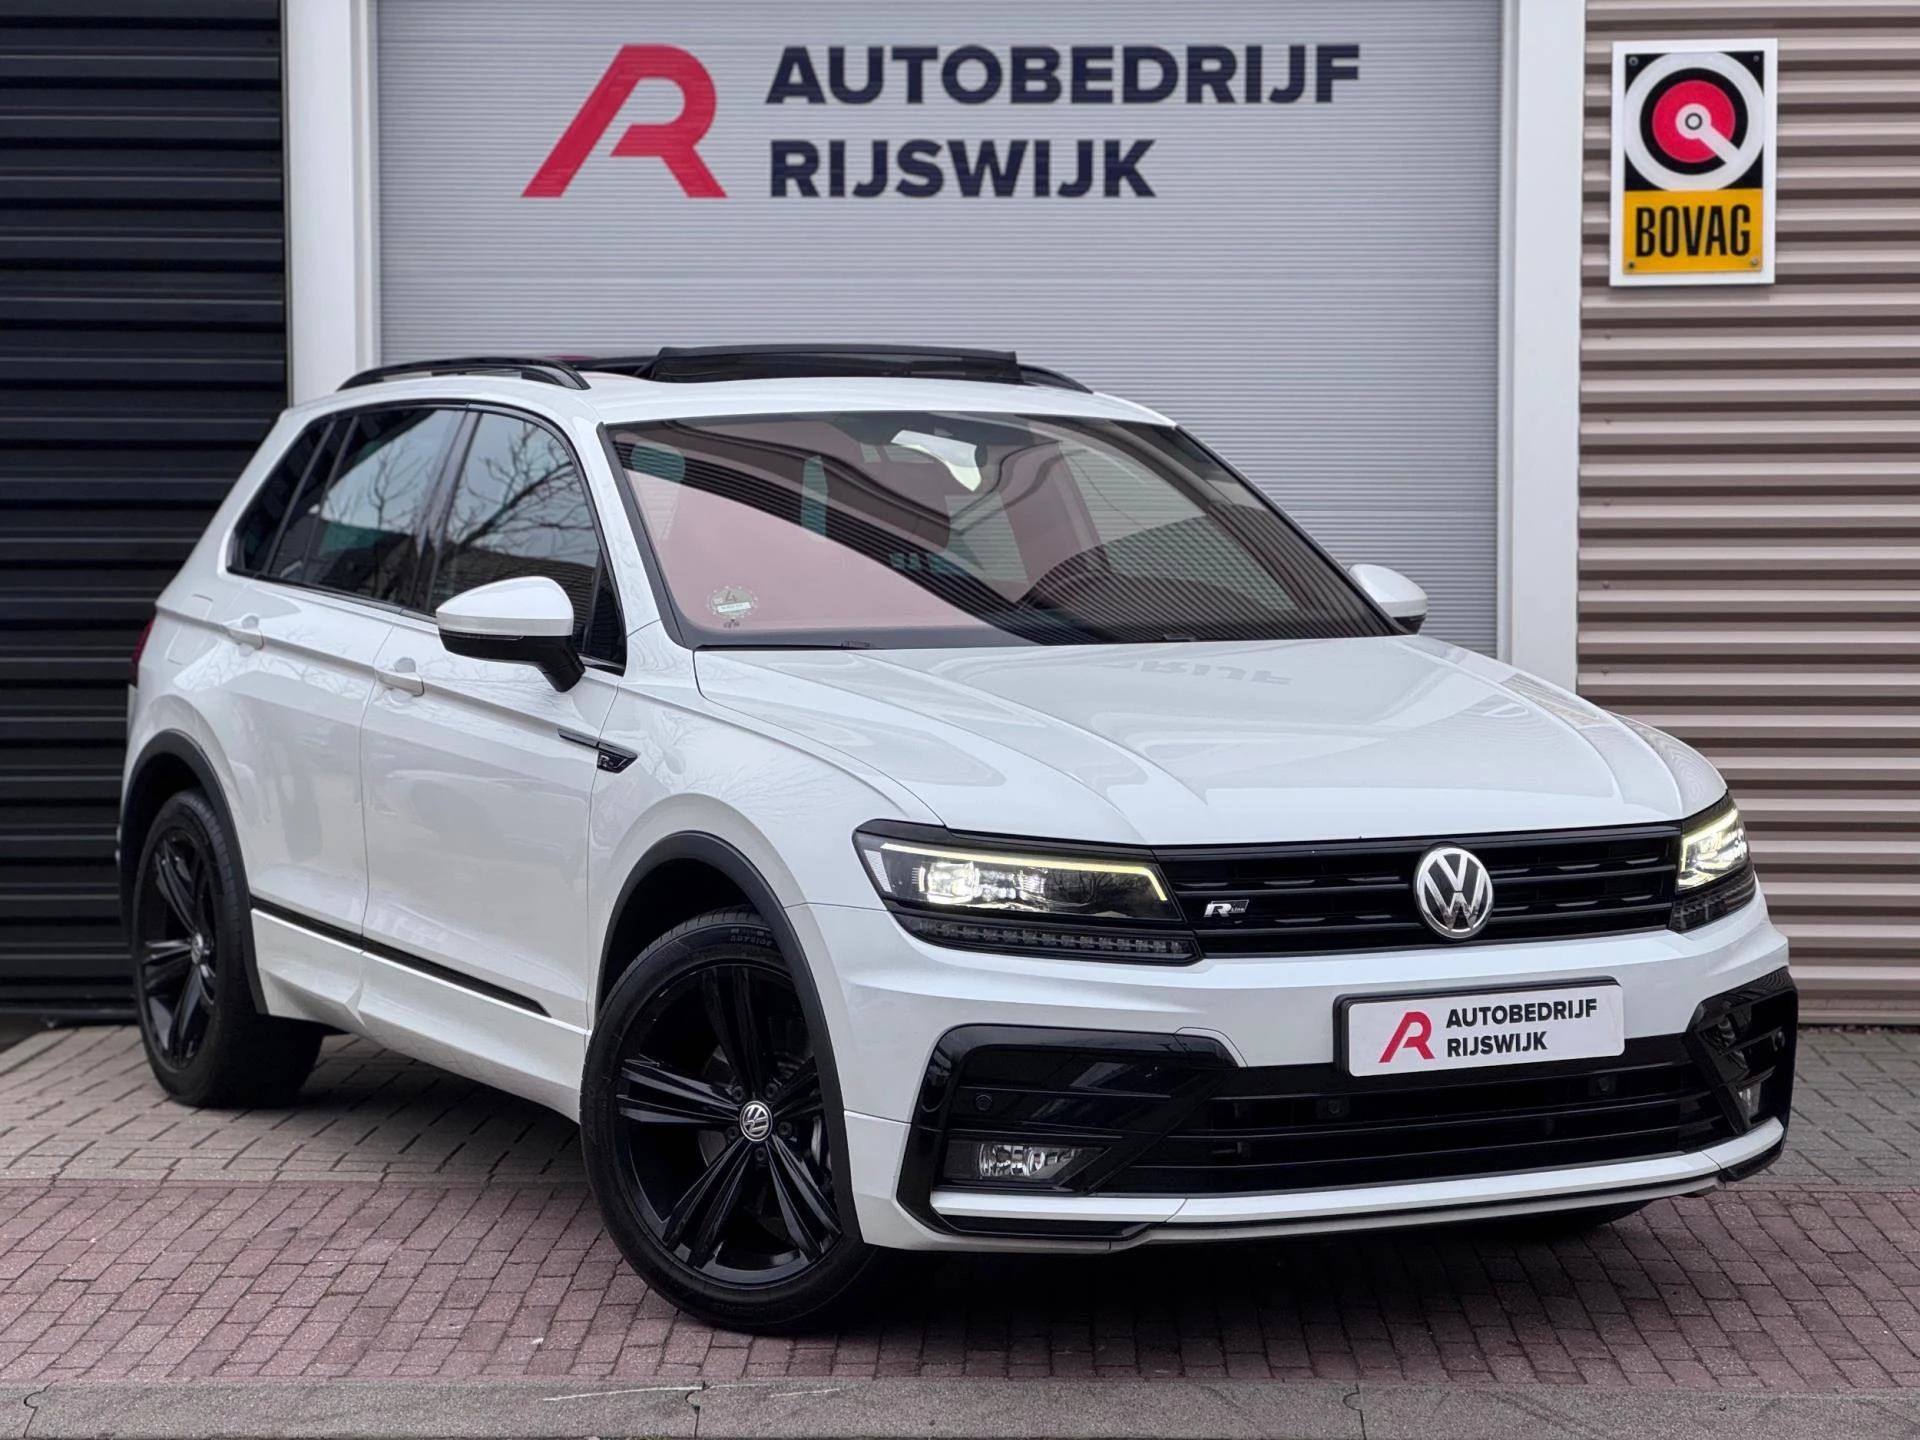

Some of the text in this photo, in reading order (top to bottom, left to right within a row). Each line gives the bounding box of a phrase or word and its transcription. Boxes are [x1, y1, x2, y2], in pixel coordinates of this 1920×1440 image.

[765, 44, 1360, 105] AUTOBEDRIJF
[770, 138, 1157, 199] RIJSWIJK
[1635, 204, 1751, 258] BOVAG
[1446, 998, 1597, 1029] AUTOBEDRIJF
[1447, 1031, 1548, 1058] RIJSWIJK
